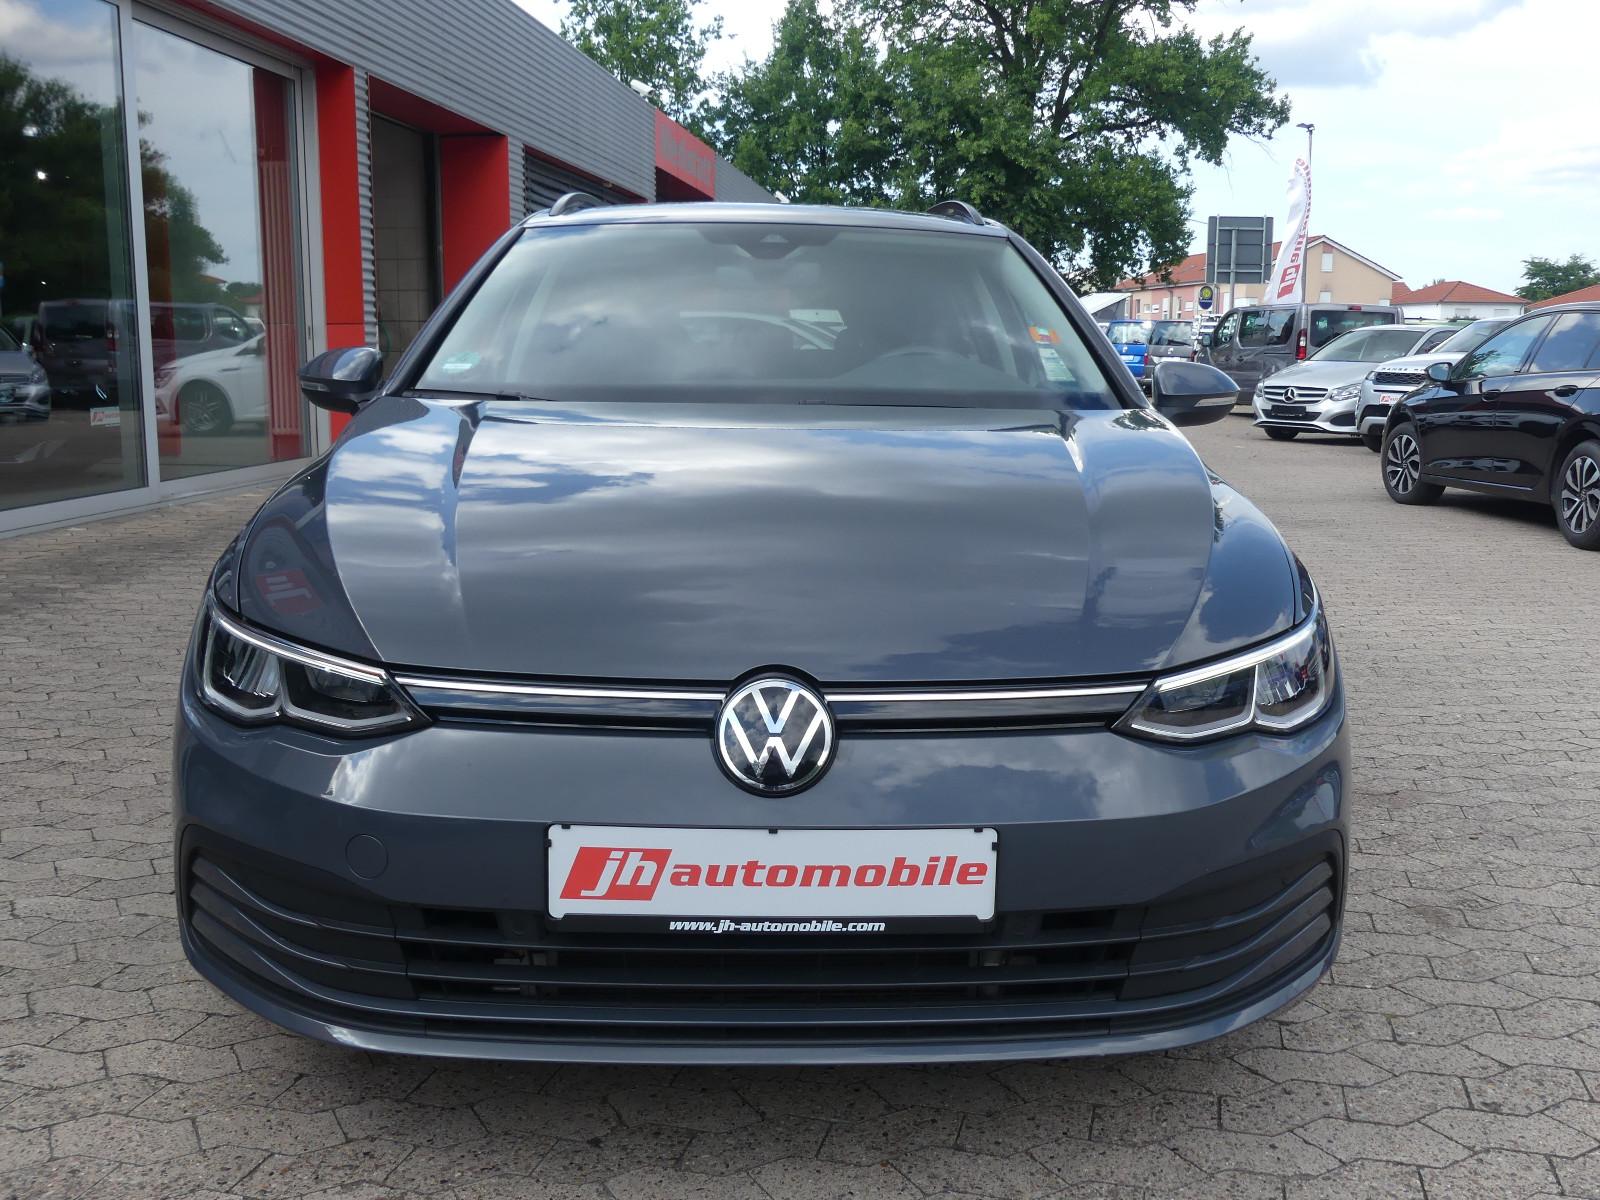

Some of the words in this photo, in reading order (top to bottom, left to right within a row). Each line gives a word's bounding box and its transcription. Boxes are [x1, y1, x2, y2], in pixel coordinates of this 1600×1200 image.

[721, 682, 831, 786] VW
[576, 849, 662, 898] jh
[669, 856, 988, 887] automobile
[669, 919, 886, 933] www.jh-automobile.com
